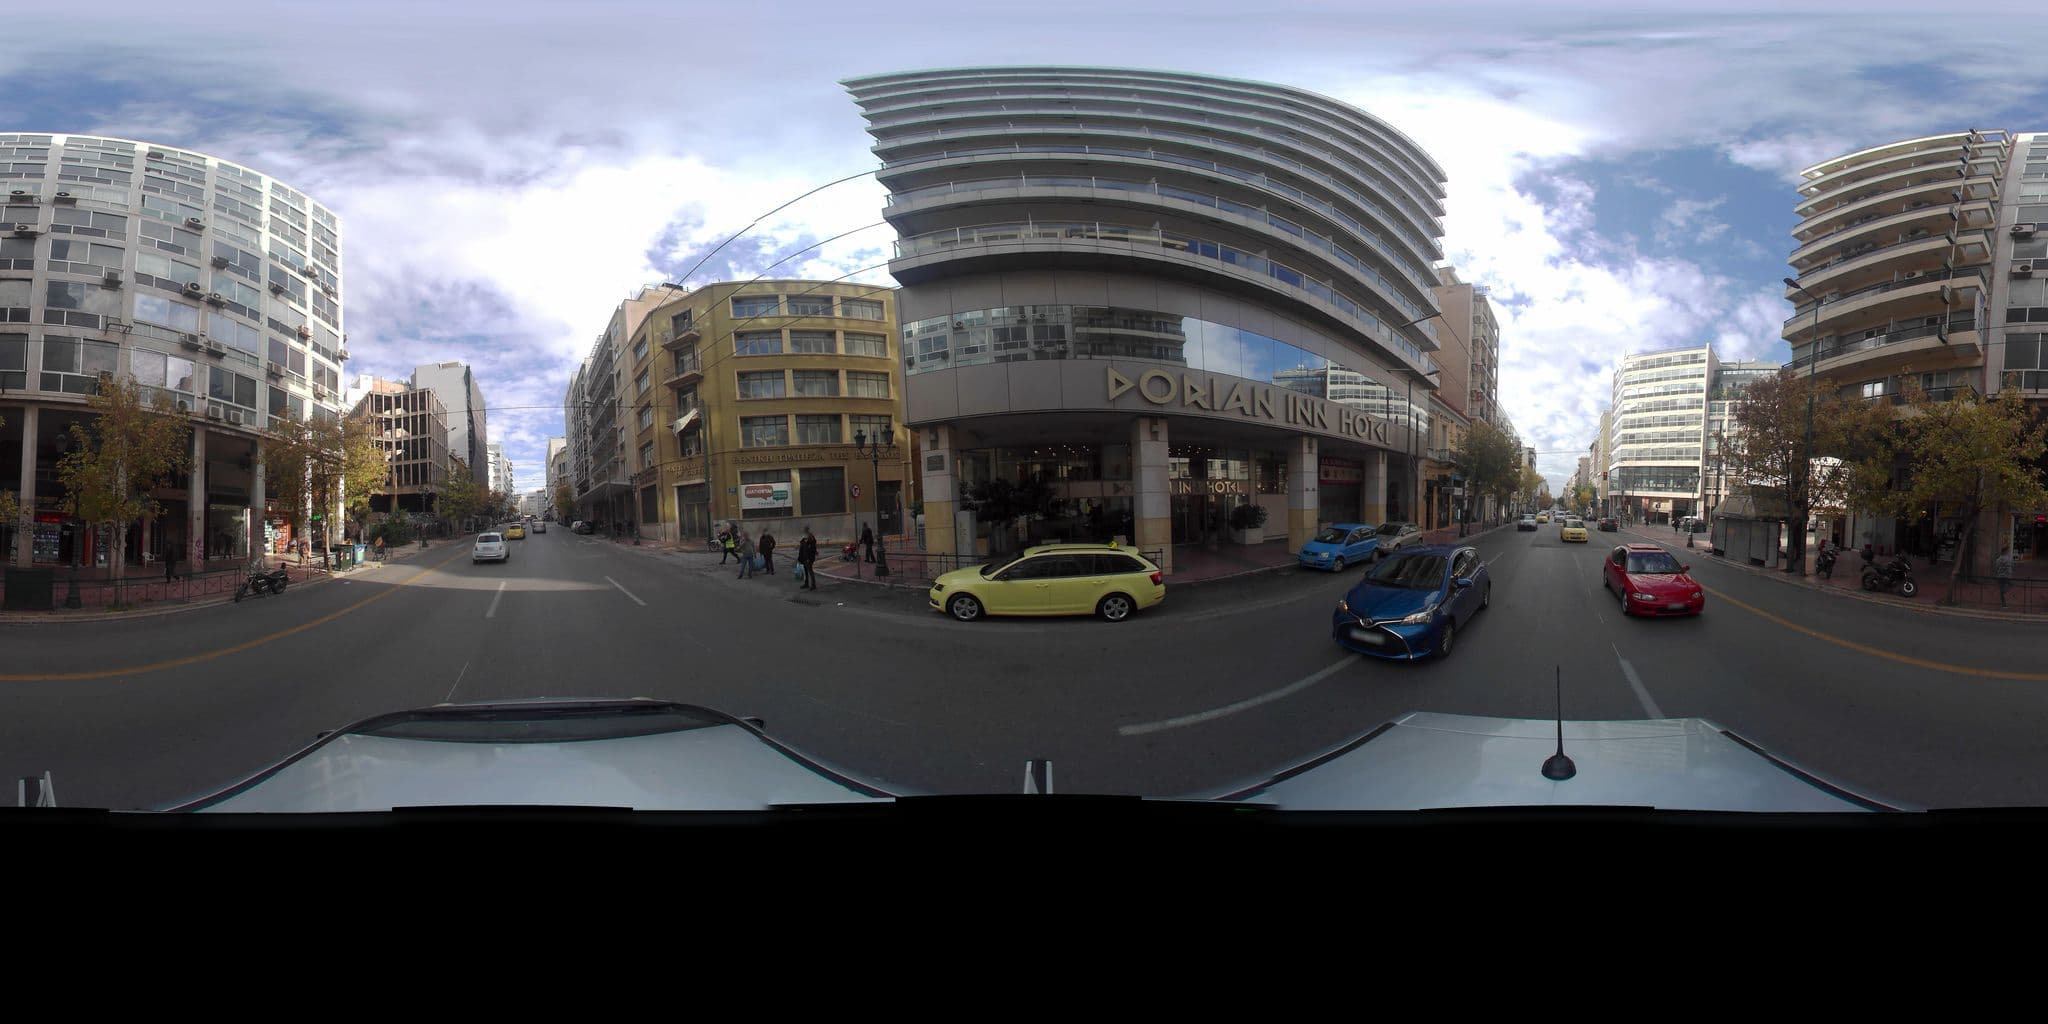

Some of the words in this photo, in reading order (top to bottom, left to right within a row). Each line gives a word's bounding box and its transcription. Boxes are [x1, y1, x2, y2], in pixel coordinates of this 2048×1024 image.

[1106, 366, 1275, 420] DORIAN
[1285, 394, 1329, 430] INN
[1339, 407, 1392, 446] HOTEL
[1206, 480, 1243, 494] HOTEL
